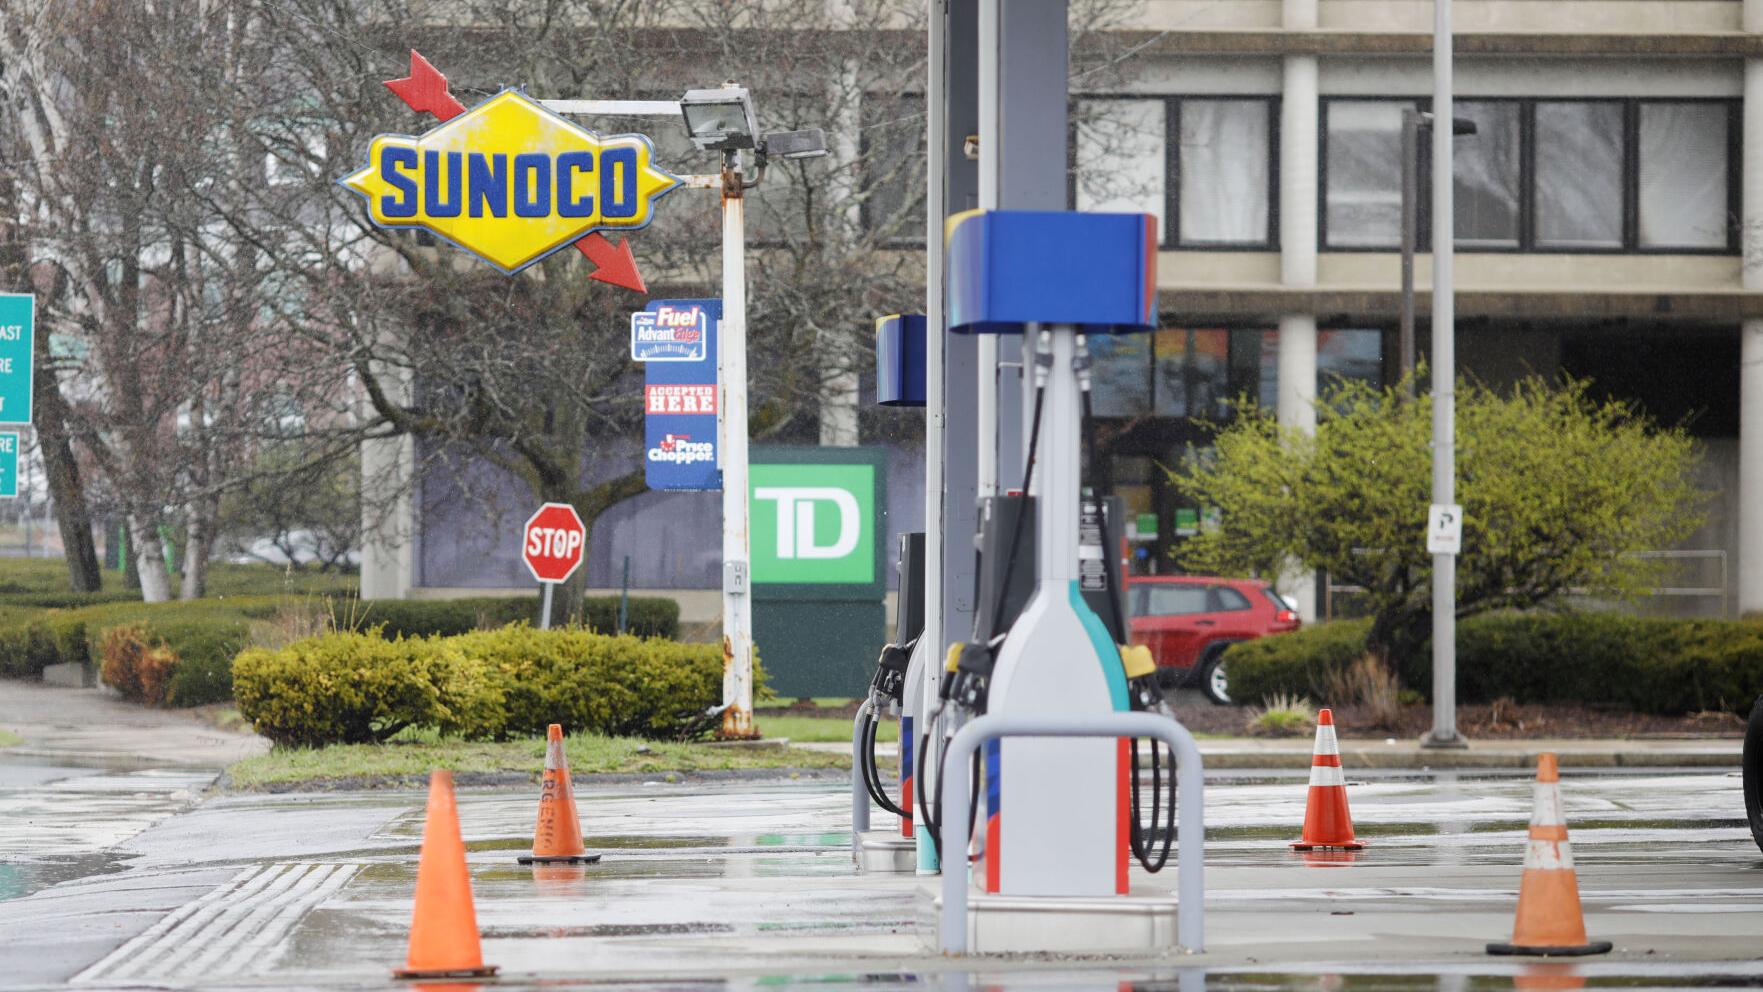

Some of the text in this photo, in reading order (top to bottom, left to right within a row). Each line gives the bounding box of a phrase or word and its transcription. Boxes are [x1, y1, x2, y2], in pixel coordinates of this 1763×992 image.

[381, 146, 637, 217] SUNOCO
[656, 305, 699, 326] Fuel
[649, 386, 713, 396] ACCEPTED
[649, 396, 714, 412] HERE
[675, 440, 714, 452] Price
[754, 487, 860, 559] TD
[527, 526, 581, 560] STOP
